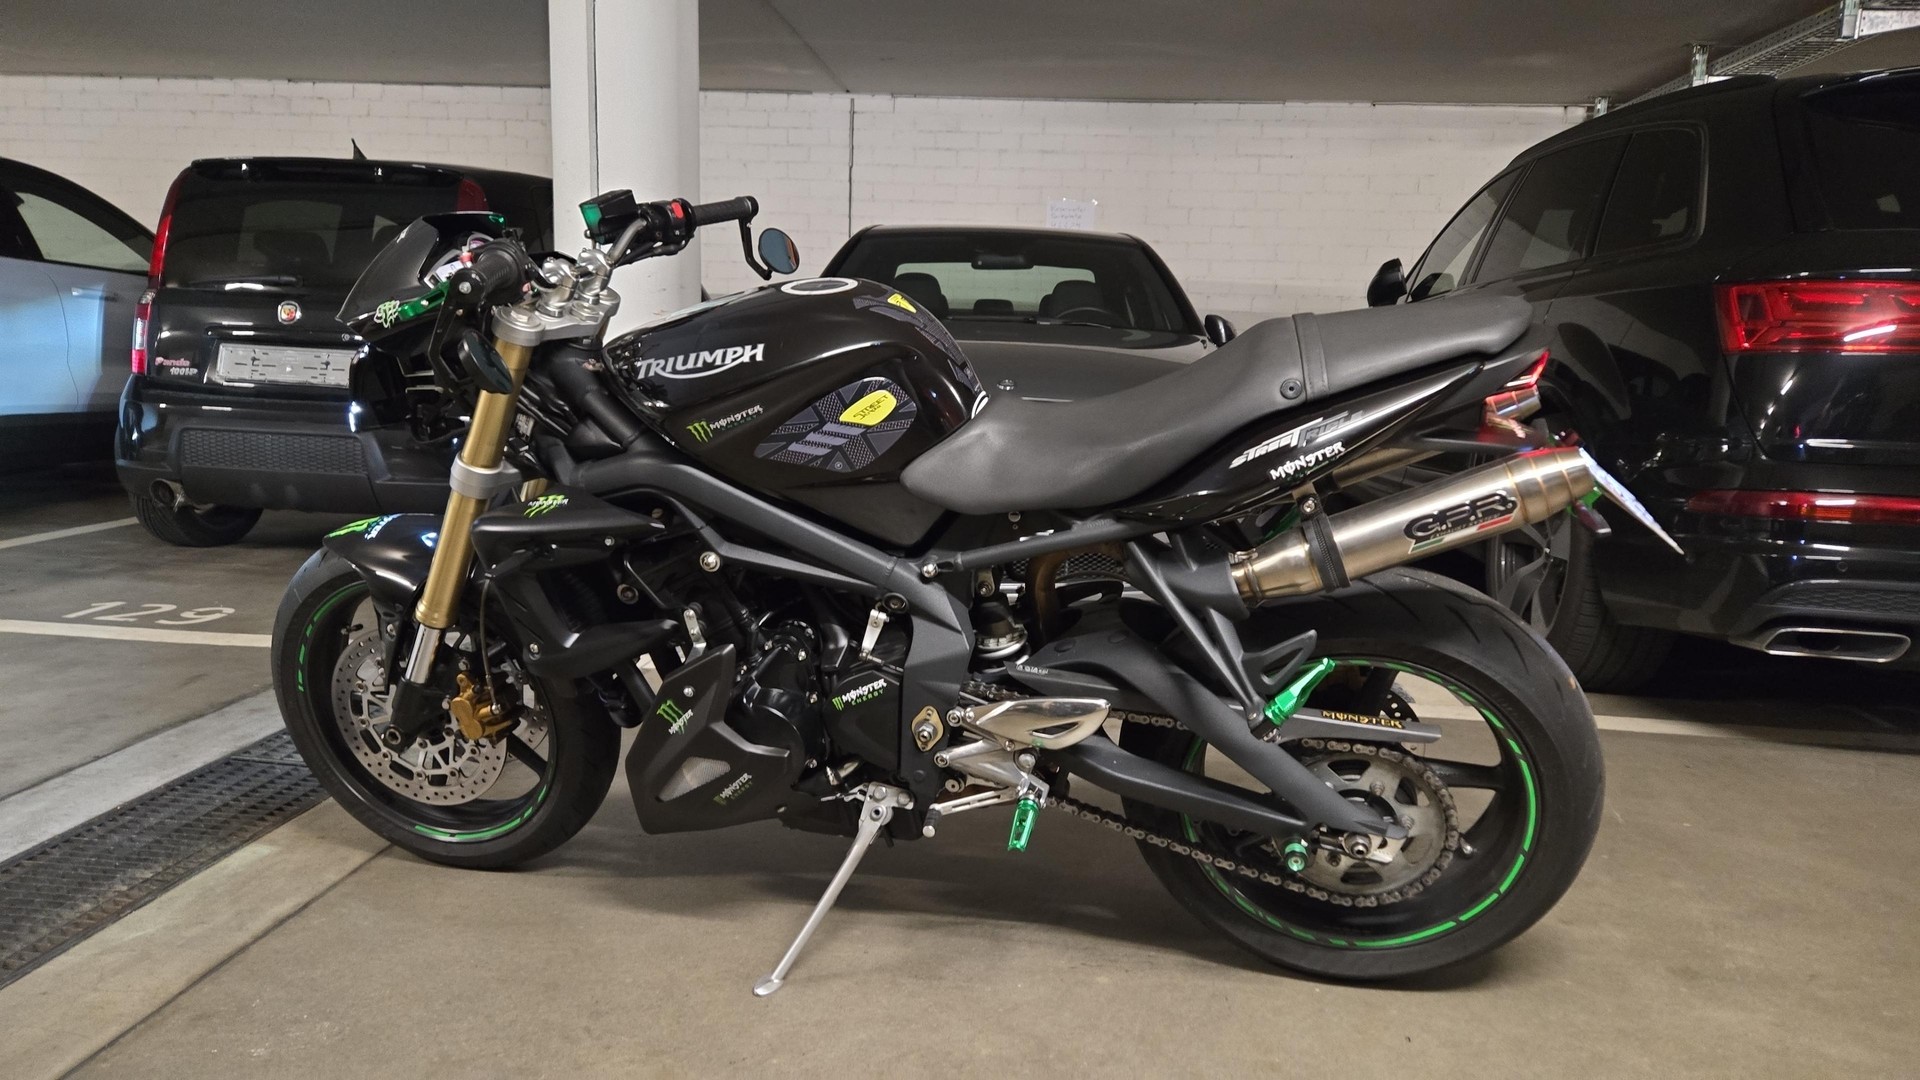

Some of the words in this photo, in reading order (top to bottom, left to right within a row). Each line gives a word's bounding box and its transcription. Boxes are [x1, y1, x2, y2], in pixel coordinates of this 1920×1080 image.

[154, 356, 191, 366] Panda
[170, 366, 198, 376] 100HP
[636, 343, 765, 380] TRIUMPH
[709, 404, 763, 431] MONSTER
[853, 394, 888, 419] STREET
[1269, 441, 1345, 480] MONSTER
[61, 600, 236, 625] 129
[841, 678, 888, 703] MONSTER
[851, 688, 884, 706] ENERGY
[1322, 710, 1404, 729] MONSTER
[720, 772, 752, 799] MONSTER
